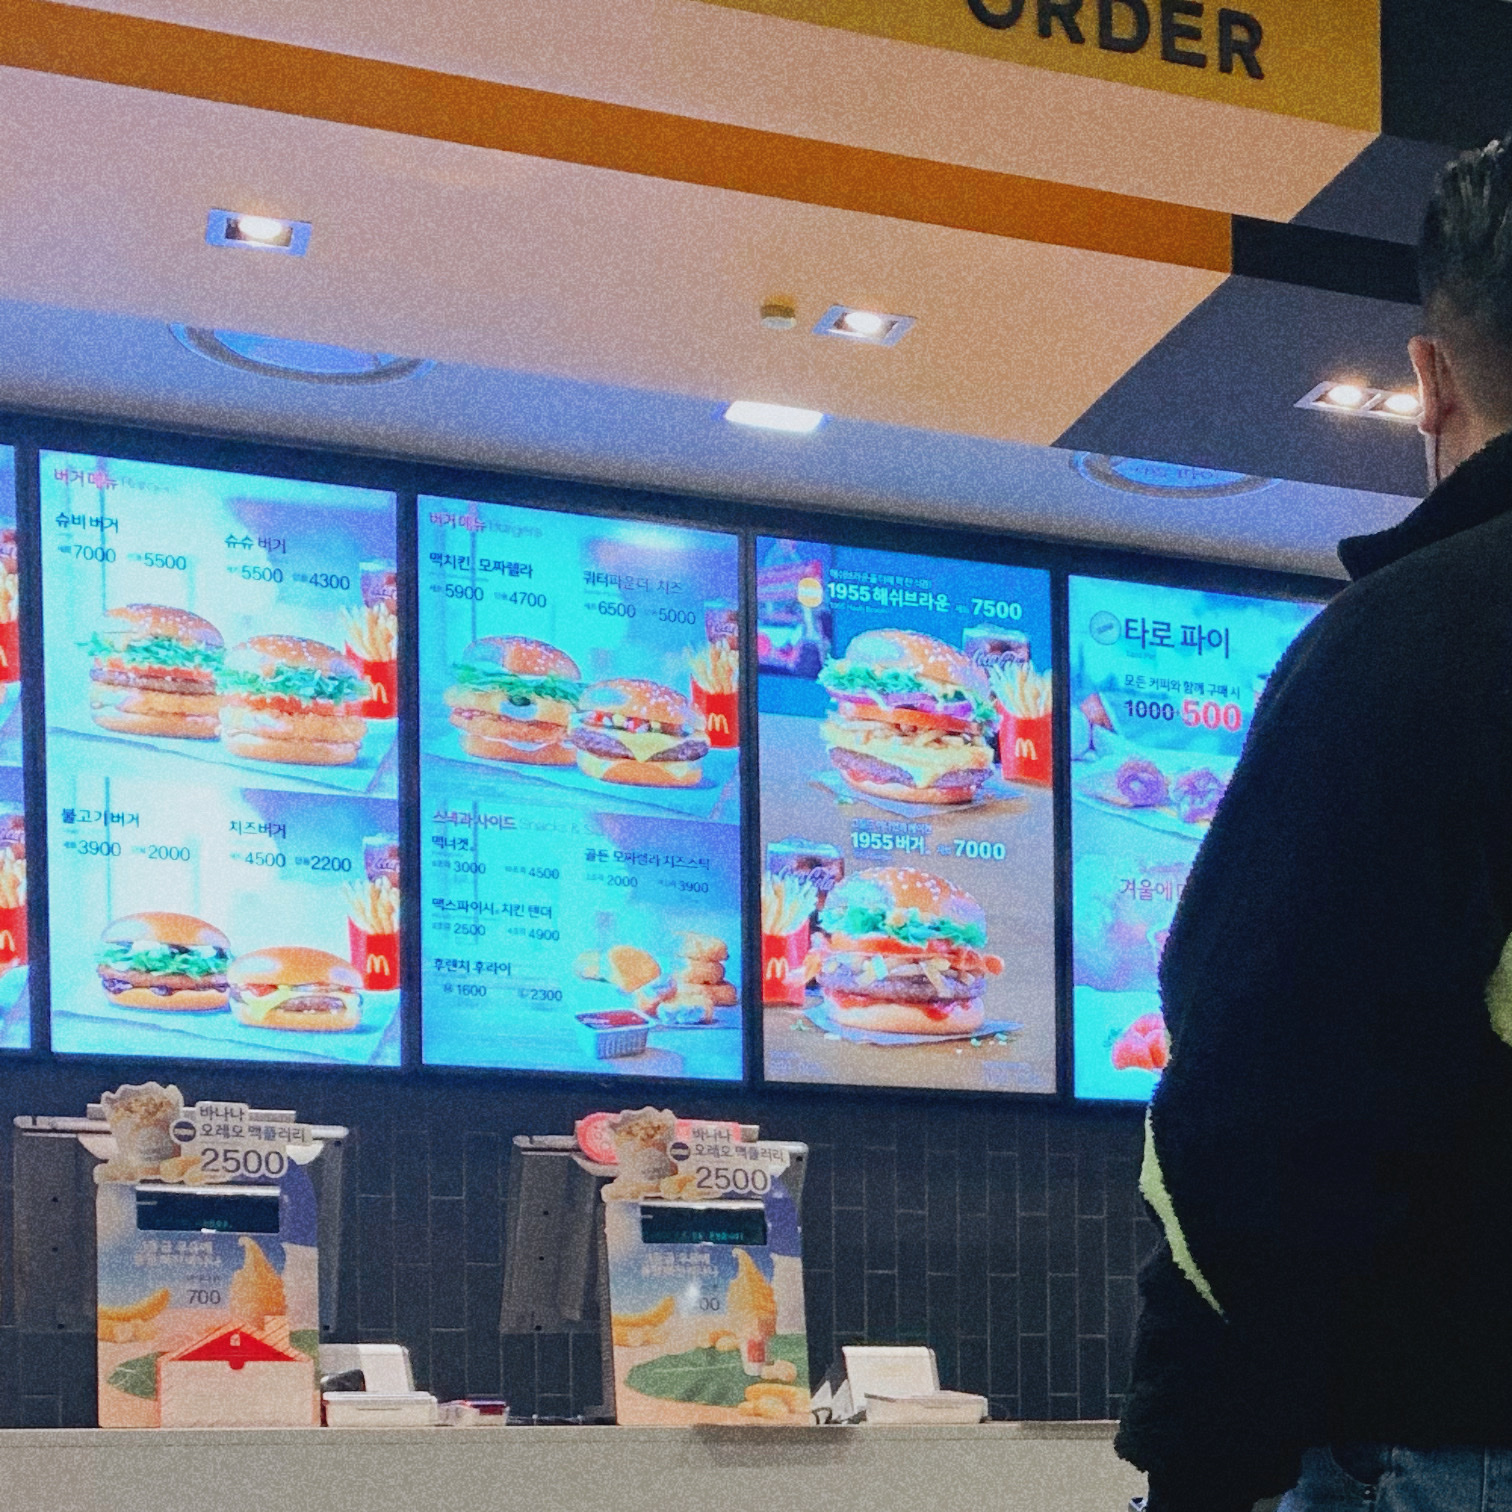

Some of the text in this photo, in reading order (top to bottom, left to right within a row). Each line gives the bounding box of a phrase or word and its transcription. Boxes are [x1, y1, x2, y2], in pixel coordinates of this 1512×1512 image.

[73, 544, 117, 563] 7000
[144, 552, 187, 570] 5500
[241, 565, 284, 583] 5500
[309, 573, 350, 591] 4300
[445, 583, 485, 601] 5900
[656, 579, 684, 595] 치즈
[508, 591, 548, 608] 4700
[598, 600, 637, 618] 6500
[659, 607, 697, 625] 5000
[971, 597, 1023, 621] 7500
[1124, 617, 1229, 660] 타로 파이
[1124, 674, 1147, 690] 모든
[1149, 677, 1182, 694] 커피와
[1231, 686, 1241, 700] 시
[1124, 697, 1243, 733] 1000 500
[77, 840, 121, 856] 3900
[148, 844, 190, 861] 2000
[953, 839, 1006, 860] 7000
[245, 852, 286, 868] 4500
[311, 855, 352, 872] 2200
[454, 860, 486, 874] 3000
[528, 867, 560, 880] 4500
[607, 873, 638, 887] 2000
[1119, 878, 1173, 902] 겨울에
[453, 922, 486, 936] 2500
[528, 928, 560, 941] 4900
[530, 988, 563, 1002] 2300
[200, 1105, 246, 1122] 바나나
[201, 1122, 245, 1140] 오레오
[692, 1127, 733, 1142] 바나나
[694, 1143, 733, 1159] 오레오
[200, 1147, 286, 1176] 2500
[695, 1165, 769, 1192] 2500
[187, 1289, 222, 1306] 700
